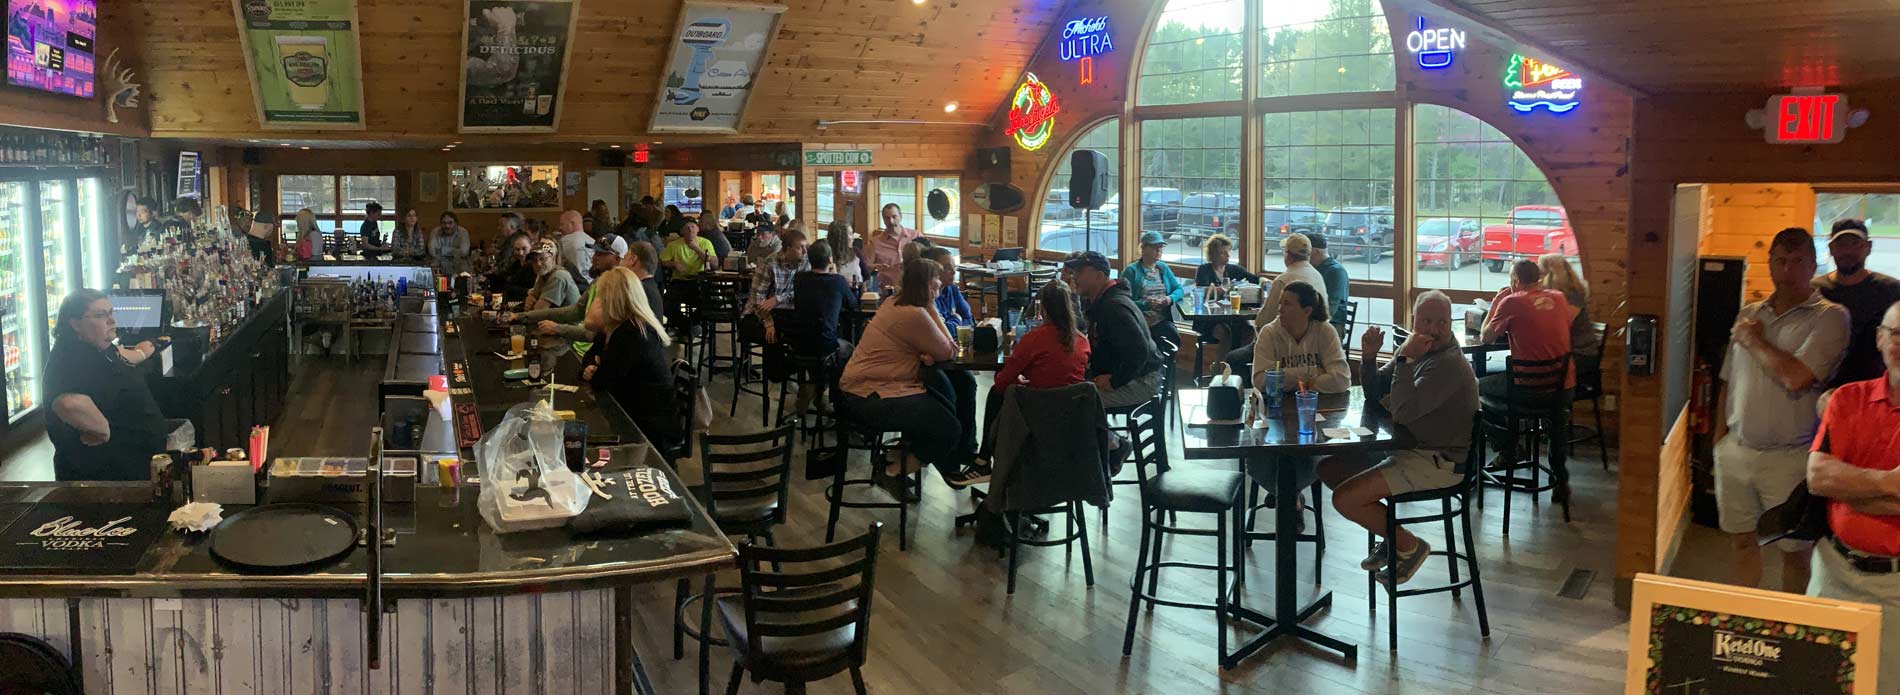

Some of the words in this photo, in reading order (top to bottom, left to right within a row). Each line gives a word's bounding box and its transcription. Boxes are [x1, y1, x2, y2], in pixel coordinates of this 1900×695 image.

[685, 29, 723, 38] OUTBOARD
[1407, 28, 1465, 51] OPEN
[479, 45, 556, 54] DELICIOUS
[1060, 33, 1112, 60] ULTRA
[1777, 95, 1839, 140] EXIT
[634, 151, 648, 163] EXIT
[815, 152, 844, 164] SPOTTED
[845, 152, 859, 164] COW
[42, 540, 104, 548] VODKA
[1715, 633, 1753, 658] Ketel
[1754, 640, 1781, 659] One
